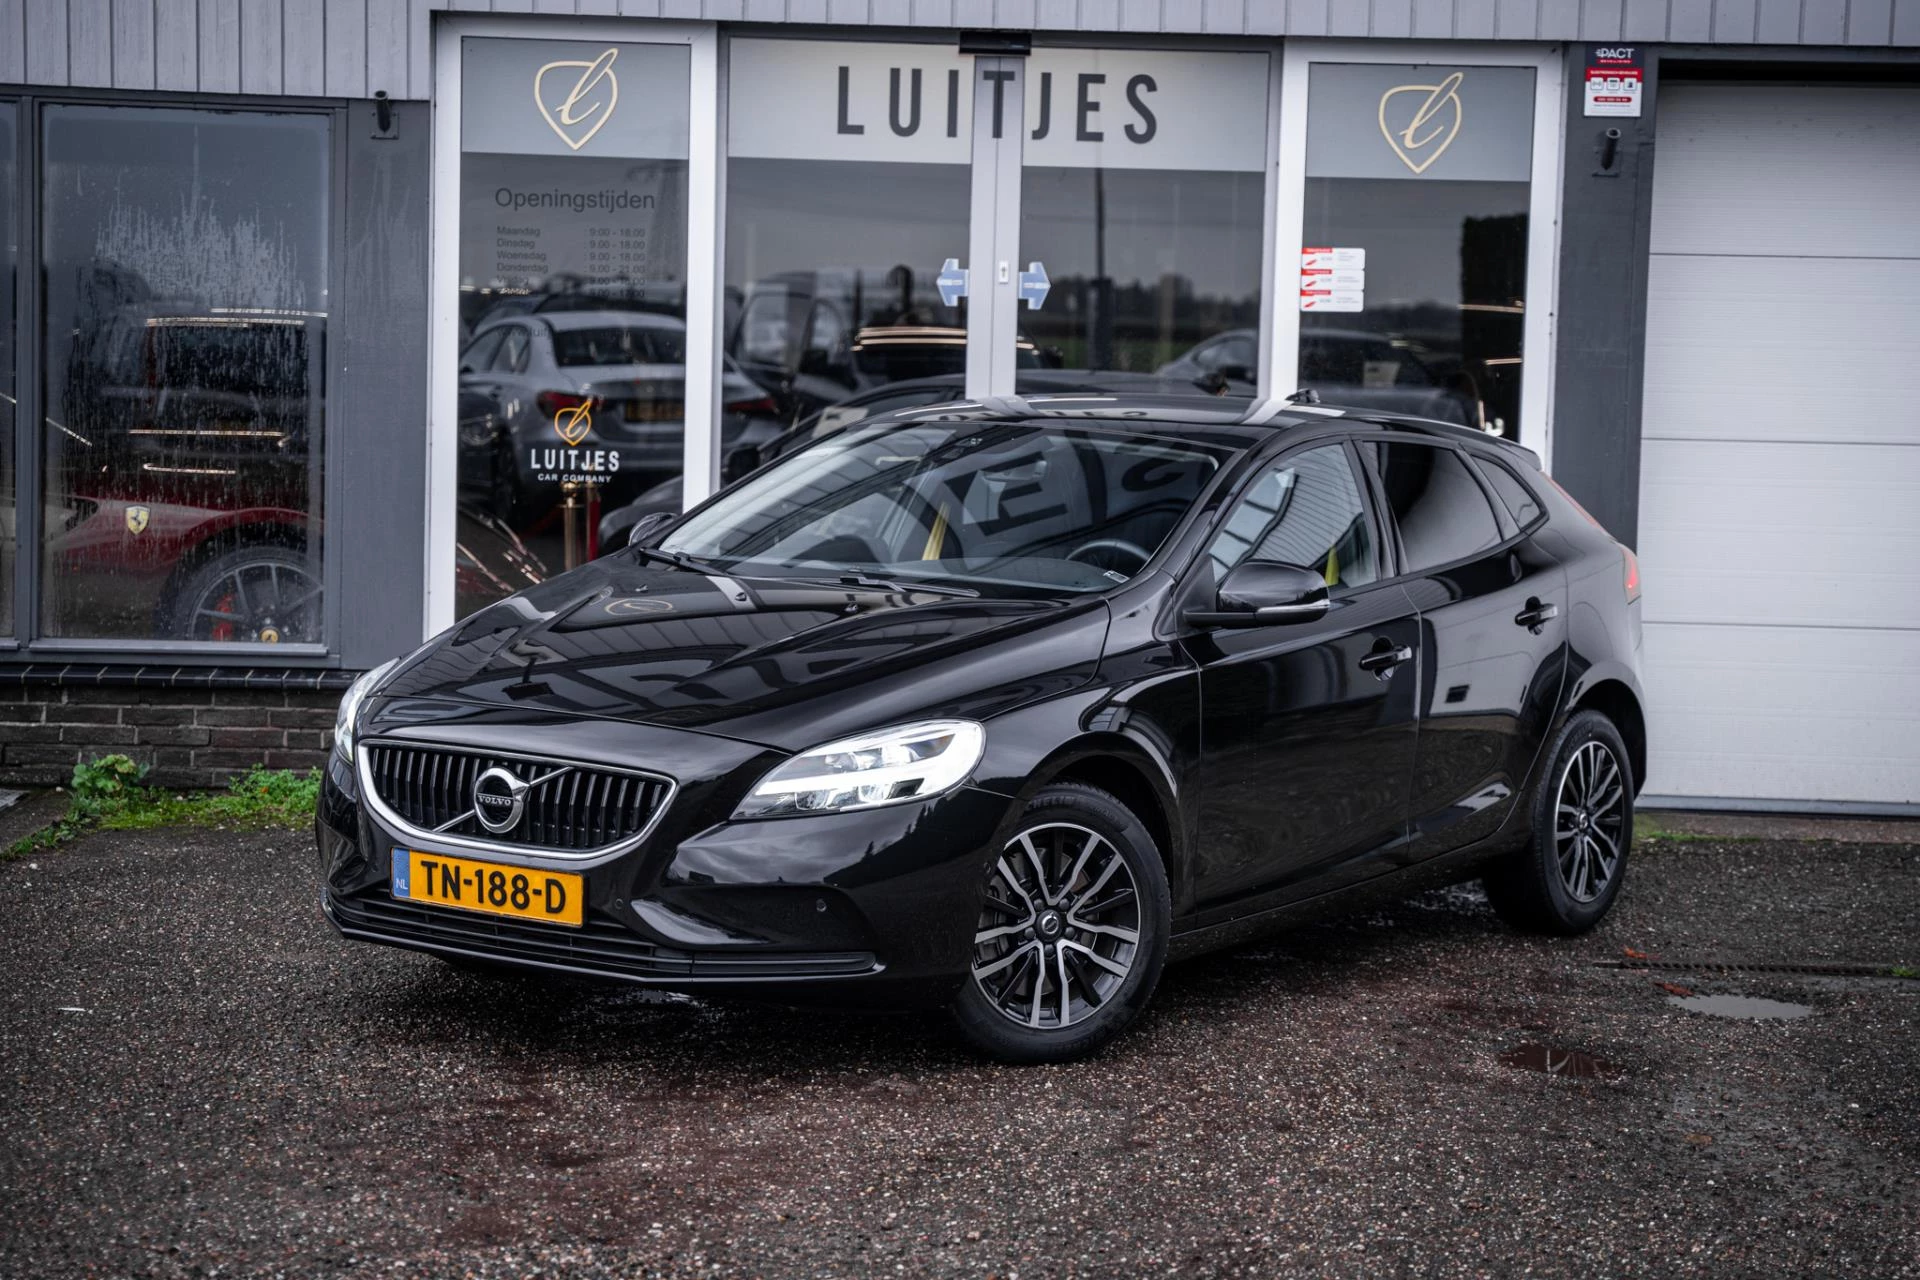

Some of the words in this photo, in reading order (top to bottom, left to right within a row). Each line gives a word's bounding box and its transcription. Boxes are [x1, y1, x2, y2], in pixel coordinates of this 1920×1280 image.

[837, 65, 1158, 144] LUITJES
[494, 187, 656, 213] Openingstijden
[496, 225, 541, 238] Maandag
[496, 238, 536, 250] Dinsdag
[496, 250, 547, 262] Woensdag
[496, 262, 549, 274] Donderdag
[530, 448, 620, 472] LUITJES
[537, 473, 558, 481] CAR
[562, 473, 612, 483] COMPANY
[478, 795, 511, 806] VOLVO
[395, 878, 409, 890] NL
[420, 860, 567, 915] TN-188-D
